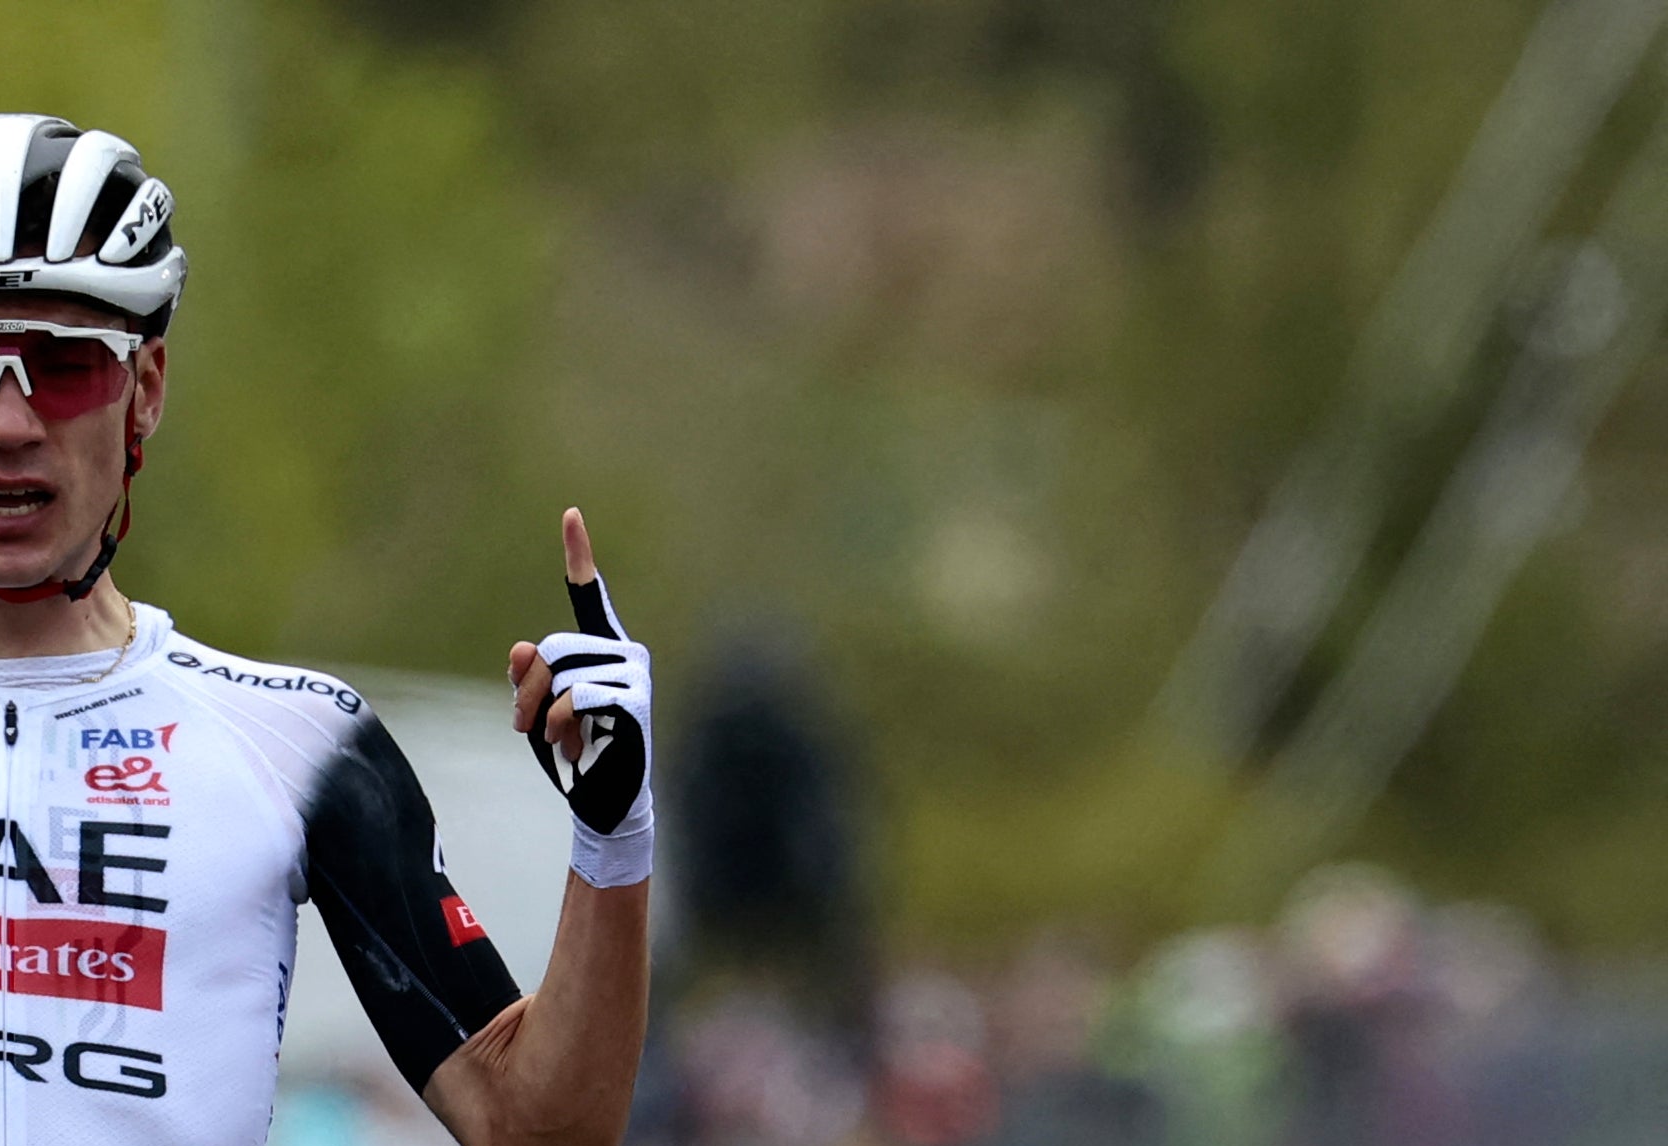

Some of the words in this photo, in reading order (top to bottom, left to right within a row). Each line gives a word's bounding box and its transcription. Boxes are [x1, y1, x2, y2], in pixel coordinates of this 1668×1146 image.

[54, 698, 109, 721] RICHARD
[108, 687, 145, 704] MILLE
[202, 666, 363, 715] Analog
[143, 796, 171, 806] and
